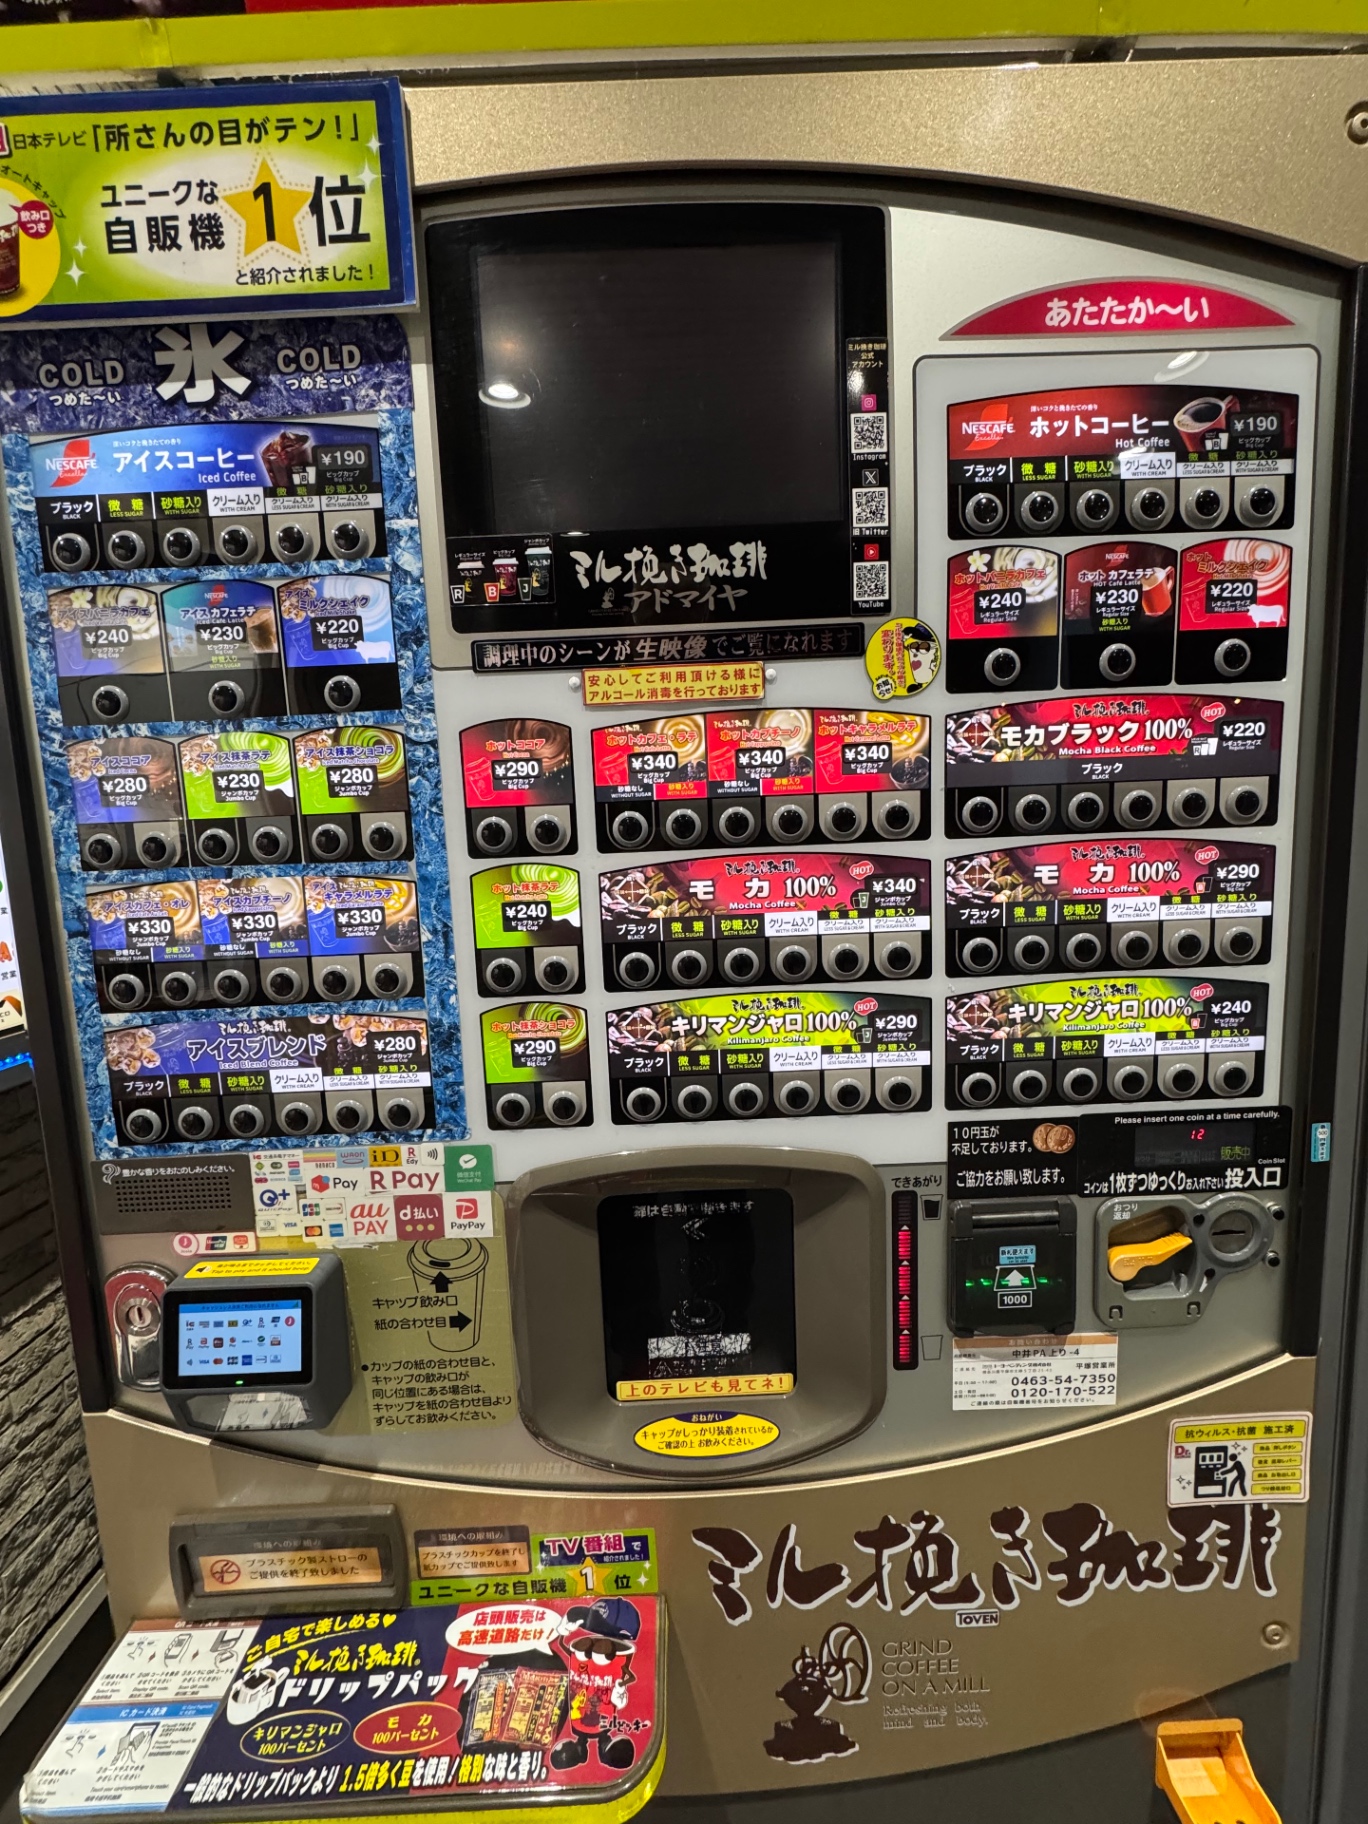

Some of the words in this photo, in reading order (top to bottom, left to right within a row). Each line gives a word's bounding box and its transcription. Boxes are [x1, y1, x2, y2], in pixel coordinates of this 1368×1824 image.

[101, 179, 219, 207] ユニークな
[20, 210, 51, 222] 飲み口
[26, 222, 47, 234] つき
[105, 213, 225, 254] 自販機
[235, 264, 375, 286] と紹介されました！
[154, 322, 252, 403] 氷
[276, 345, 361, 373] COLD
[861, 352, 875, 360] 公式
[39, 360, 125, 387] COLD
[1029, 413, 1170, 438] ホットコーヒー
[1233, 416, 1278, 432] ¥190
[1115, 438, 1134, 448] Hot
[1138, 437, 1171, 448] Coffee
[113, 448, 254, 473] アイスコーヒー
[321, 450, 365, 466] ¥190
[1123, 459, 1173, 471] クリーム入り
[198, 473, 217, 483] Iced
[223, 471, 256, 482] Coffee
[963, 464, 1007, 476] ブラック
[50, 501, 93, 514] ブラック
[160, 497, 202, 510] 砂糖入り
[212, 494, 261, 507] クリーム入り
[954, 569, 1047, 585] ホットバニラカフェ
[623, 584, 749, 614] アドマイヤ
[1095, 588, 1139, 605] ¥230
[1210, 583, 1254, 599] ¥220
[299, 596, 369, 610] ミルクシェイク
[978, 592, 1022, 609] ¥240
[200, 626, 244, 642] ¥230
[316, 619, 359, 634] ¥220
[85, 629, 129, 644] ¥240
[587, 667, 761, 688] 安心してご利用頂ける様に
[587, 683, 763, 703] アルコール消毒を行っております
[818, 721, 917, 737] ホットキャラメルラテ
[1222, 722, 1266, 738] ¥220
[305, 745, 395, 758] アイス抹茶ショコラ
[485, 738, 546, 751] ホットココア
[1059, 747, 1092, 756] Mocha
[1094, 746, 1123, 754] Black
[1124, 744, 1156, 753] Coffee
[90, 755, 151, 767] アイスココア
[738, 750, 784, 767] ¥340
[844, 745, 890, 761] ¥340
[495, 761, 540, 778] ¥290
[631, 753, 677, 771] ¥340
[216, 773, 260, 788] ¥230
[329, 767, 373, 784] ¥280
[102, 777, 147, 793] ¥280
[1216, 863, 1260, 880] ¥290
[492, 881, 560, 894] ホット抹茶ラテ
[872, 878, 917, 894] ¥340
[324, 889, 394, 902] キャラメルラテ
[337, 909, 383, 925] ¥330
[505, 904, 548, 920] ¥240
[128, 919, 172, 935] ¥330
[232, 914, 276, 930] ¥330
[1210, 999, 1252, 1016] ¥240
[491, 1018, 576, 1032] ホット抹茶ショコラ
[875, 1014, 918, 1030] ¥290
[187, 1034, 327, 1061] アイスブレンド
[373, 1036, 416, 1051] ¥280
[514, 1040, 556, 1056] ¥290
[1114, 1116, 1142, 1124] Please
[1143, 1114, 1167, 1123] insert
[1186, 1113, 1204, 1121] coin
[1206, 1113, 1214, 1121] at
[1223, 1112, 1241, 1120] time
[1243, 1110, 1280, 1120] carefully.
[952, 1140, 1032, 1155] 不足しております。
[1220, 1145, 1250, 1160] 販売中
[371, 1149, 399, 1163] iD
[122, 1164, 235, 1178] 豊かな香りをおたのしみください。
[956, 1167, 1066, 1188] ご協力をお願い致します。
[333, 1177, 358, 1191] Pay
[392, 1170, 440, 1192] Pay
[891, 1175, 942, 1188] できあがり
[350, 1203, 390, 1219] au
[399, 1206, 438, 1221] d払い
[1113, 1203, 1138, 1212] おつり
[1113, 1211, 1131, 1220] 返却
[353, 1220, 389, 1236] PAY
[450, 1221, 486, 1231] PayPay
[372, 1295, 458, 1309] キャップ飲み口
[1002, 1295, 1028, 1305] 1000
[374, 1316, 447, 1331] 紙の合わせ目
[371, 1371, 470, 1384] キャップの飲み口が
[1011, 1373, 1116, 1387] 0463-54-7350
[372, 1384, 486, 1399] 同じ位置にある場合は、
[625, 1376, 784, 1398] 上のテレビも見てネ！
[1011, 1386, 1116, 1398] 0120-170-522
[372, 1396, 512, 1413] キャップを紙の合わせ目より
[373, 1411, 497, 1426] ずらしてお飲みください。
[691, 1413, 723, 1422] おねがい
[641, 1425, 774, 1440] キャップがしっかり装着されているか
[1263, 1424, 1295, 1435] 施工済
[246, 1553, 368, 1568] プラスチック製ストローの
[422, 1547, 526, 1561] プラスチックカップを終了し
[250, 1567, 360, 1580] ご提供を終了致しました
[473, 1609, 546, 1627] 店頭販売は
[957, 1611, 999, 1627] TOVEN
[456, 1625, 553, 1647] 高速道路だけ！
[882, 1640, 954, 1658] GRIND
[882, 1659, 959, 1677] COFFEE
[280, 1664, 478, 1708] ドリップパック
[882, 1680, 917, 1697] ON
[922, 1679, 938, 1695] A
[942, 1676, 990, 1694] MILL
[252, 1720, 342, 1743] キリマンジャロ
[372, 1727, 440, 1745] 100パーセント
[257, 1738, 327, 1757] 100パーセント
